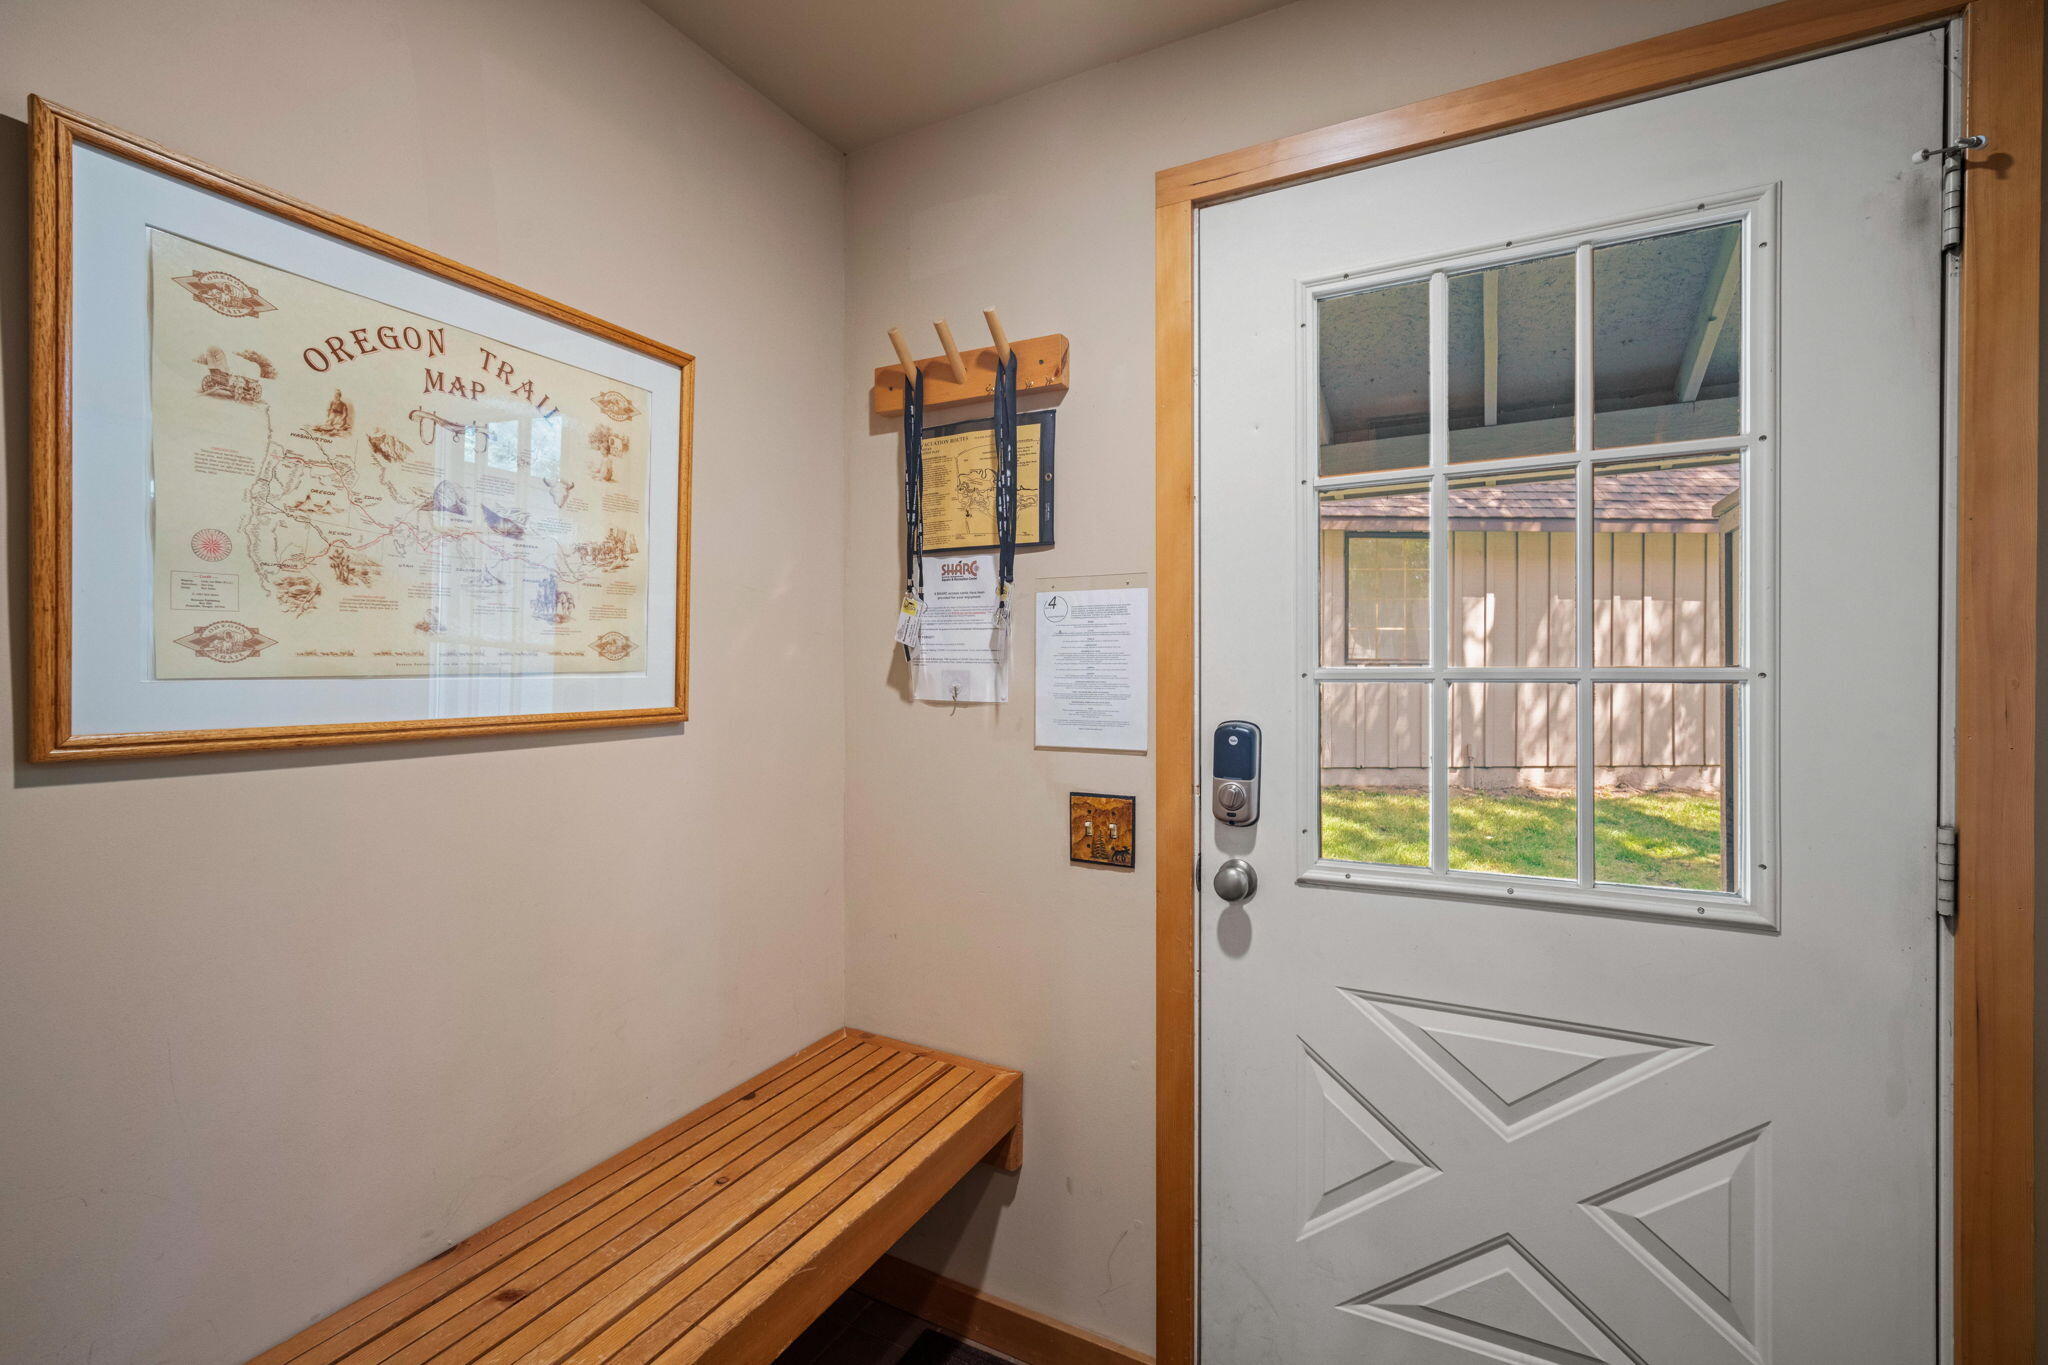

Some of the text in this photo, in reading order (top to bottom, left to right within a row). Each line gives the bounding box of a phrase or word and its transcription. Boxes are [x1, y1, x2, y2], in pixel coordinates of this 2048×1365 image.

[303, 326, 560, 426] OREGON TRAIL
[423, 367, 486, 401] MAP
[921, 439, 949, 447] VACUATION
[310, 488, 336, 496] OREGON
[941, 560, 977, 576] SHARC
[1048, 596, 1057, 610] 4
